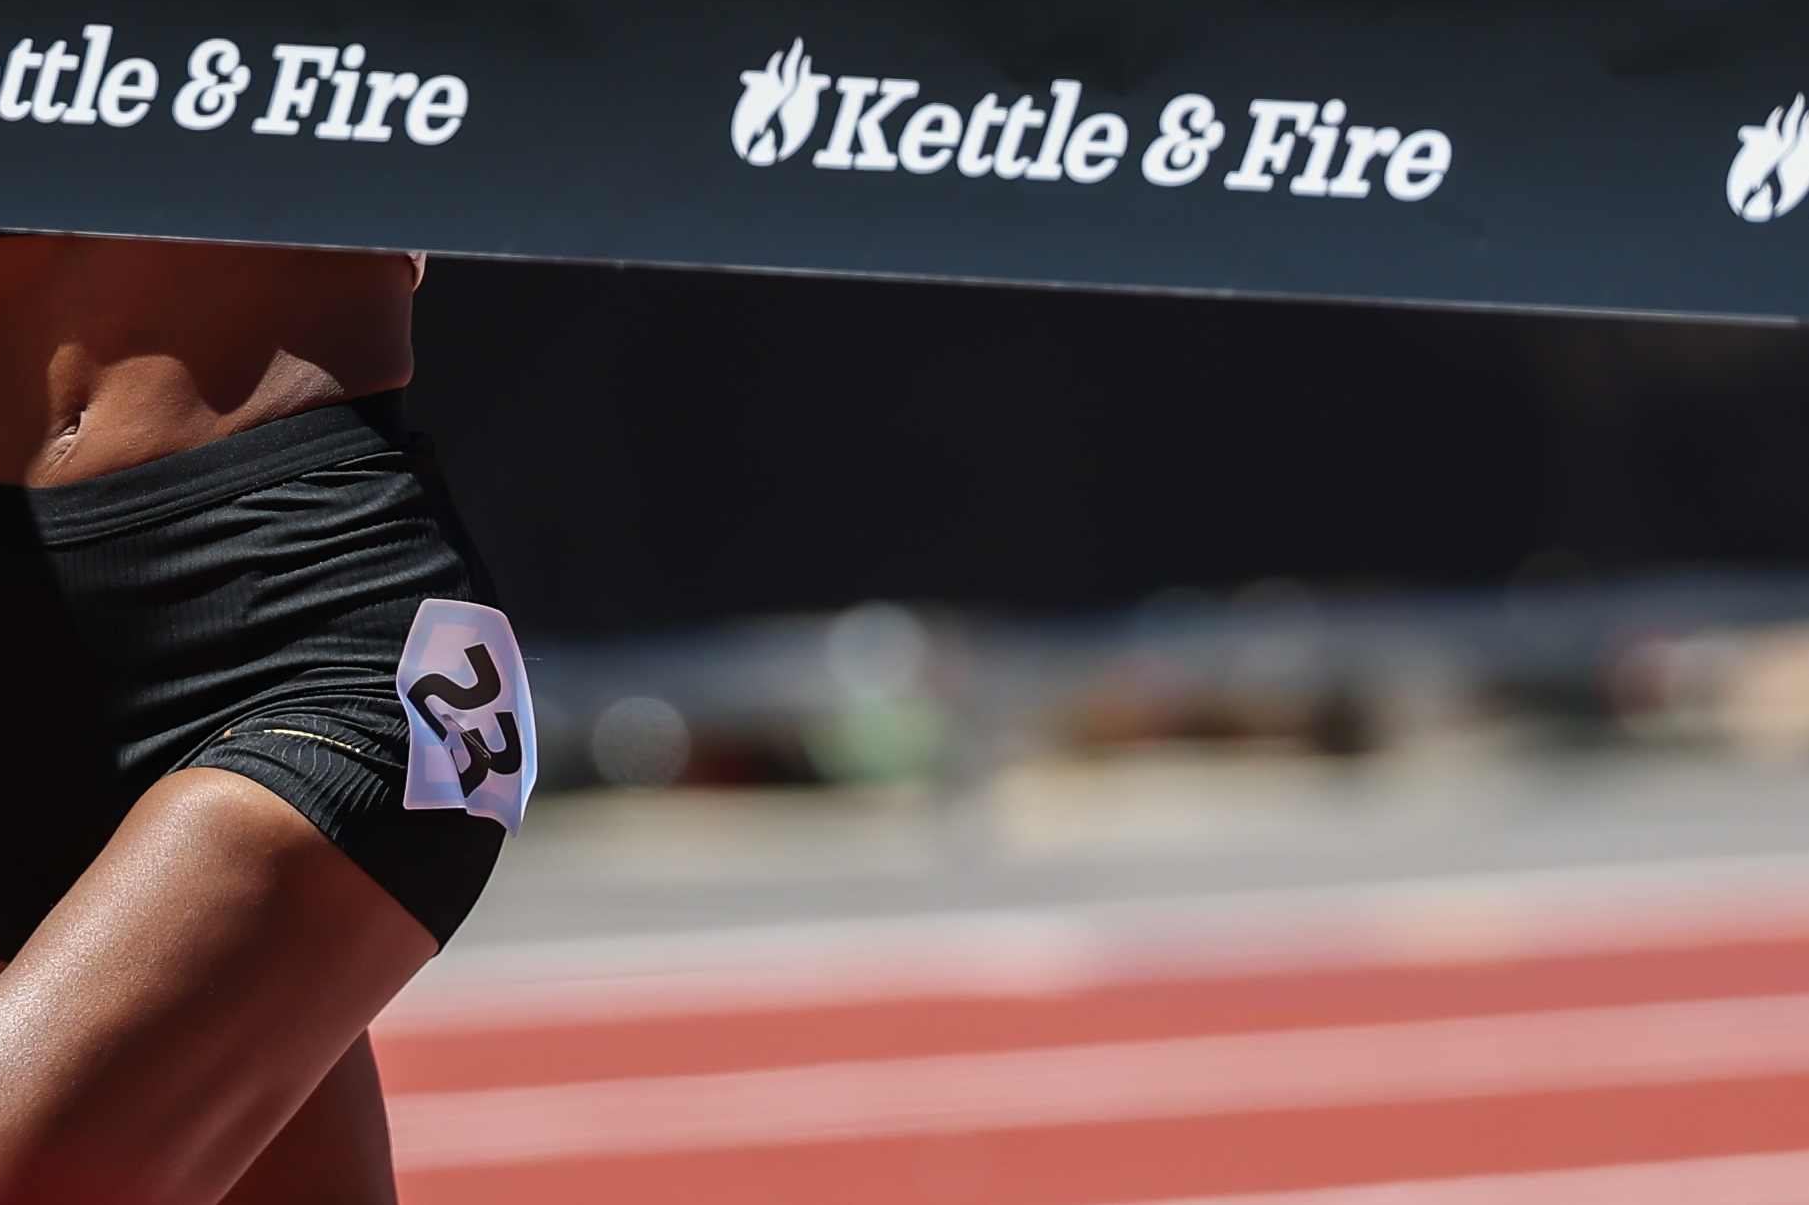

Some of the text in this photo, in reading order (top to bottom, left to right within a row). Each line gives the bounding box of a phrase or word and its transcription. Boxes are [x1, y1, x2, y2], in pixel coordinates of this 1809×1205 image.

[172, 38, 251, 131] &
[251, 43, 469, 146] Fire
[812, 76, 1453, 201] Kettle & Fire
